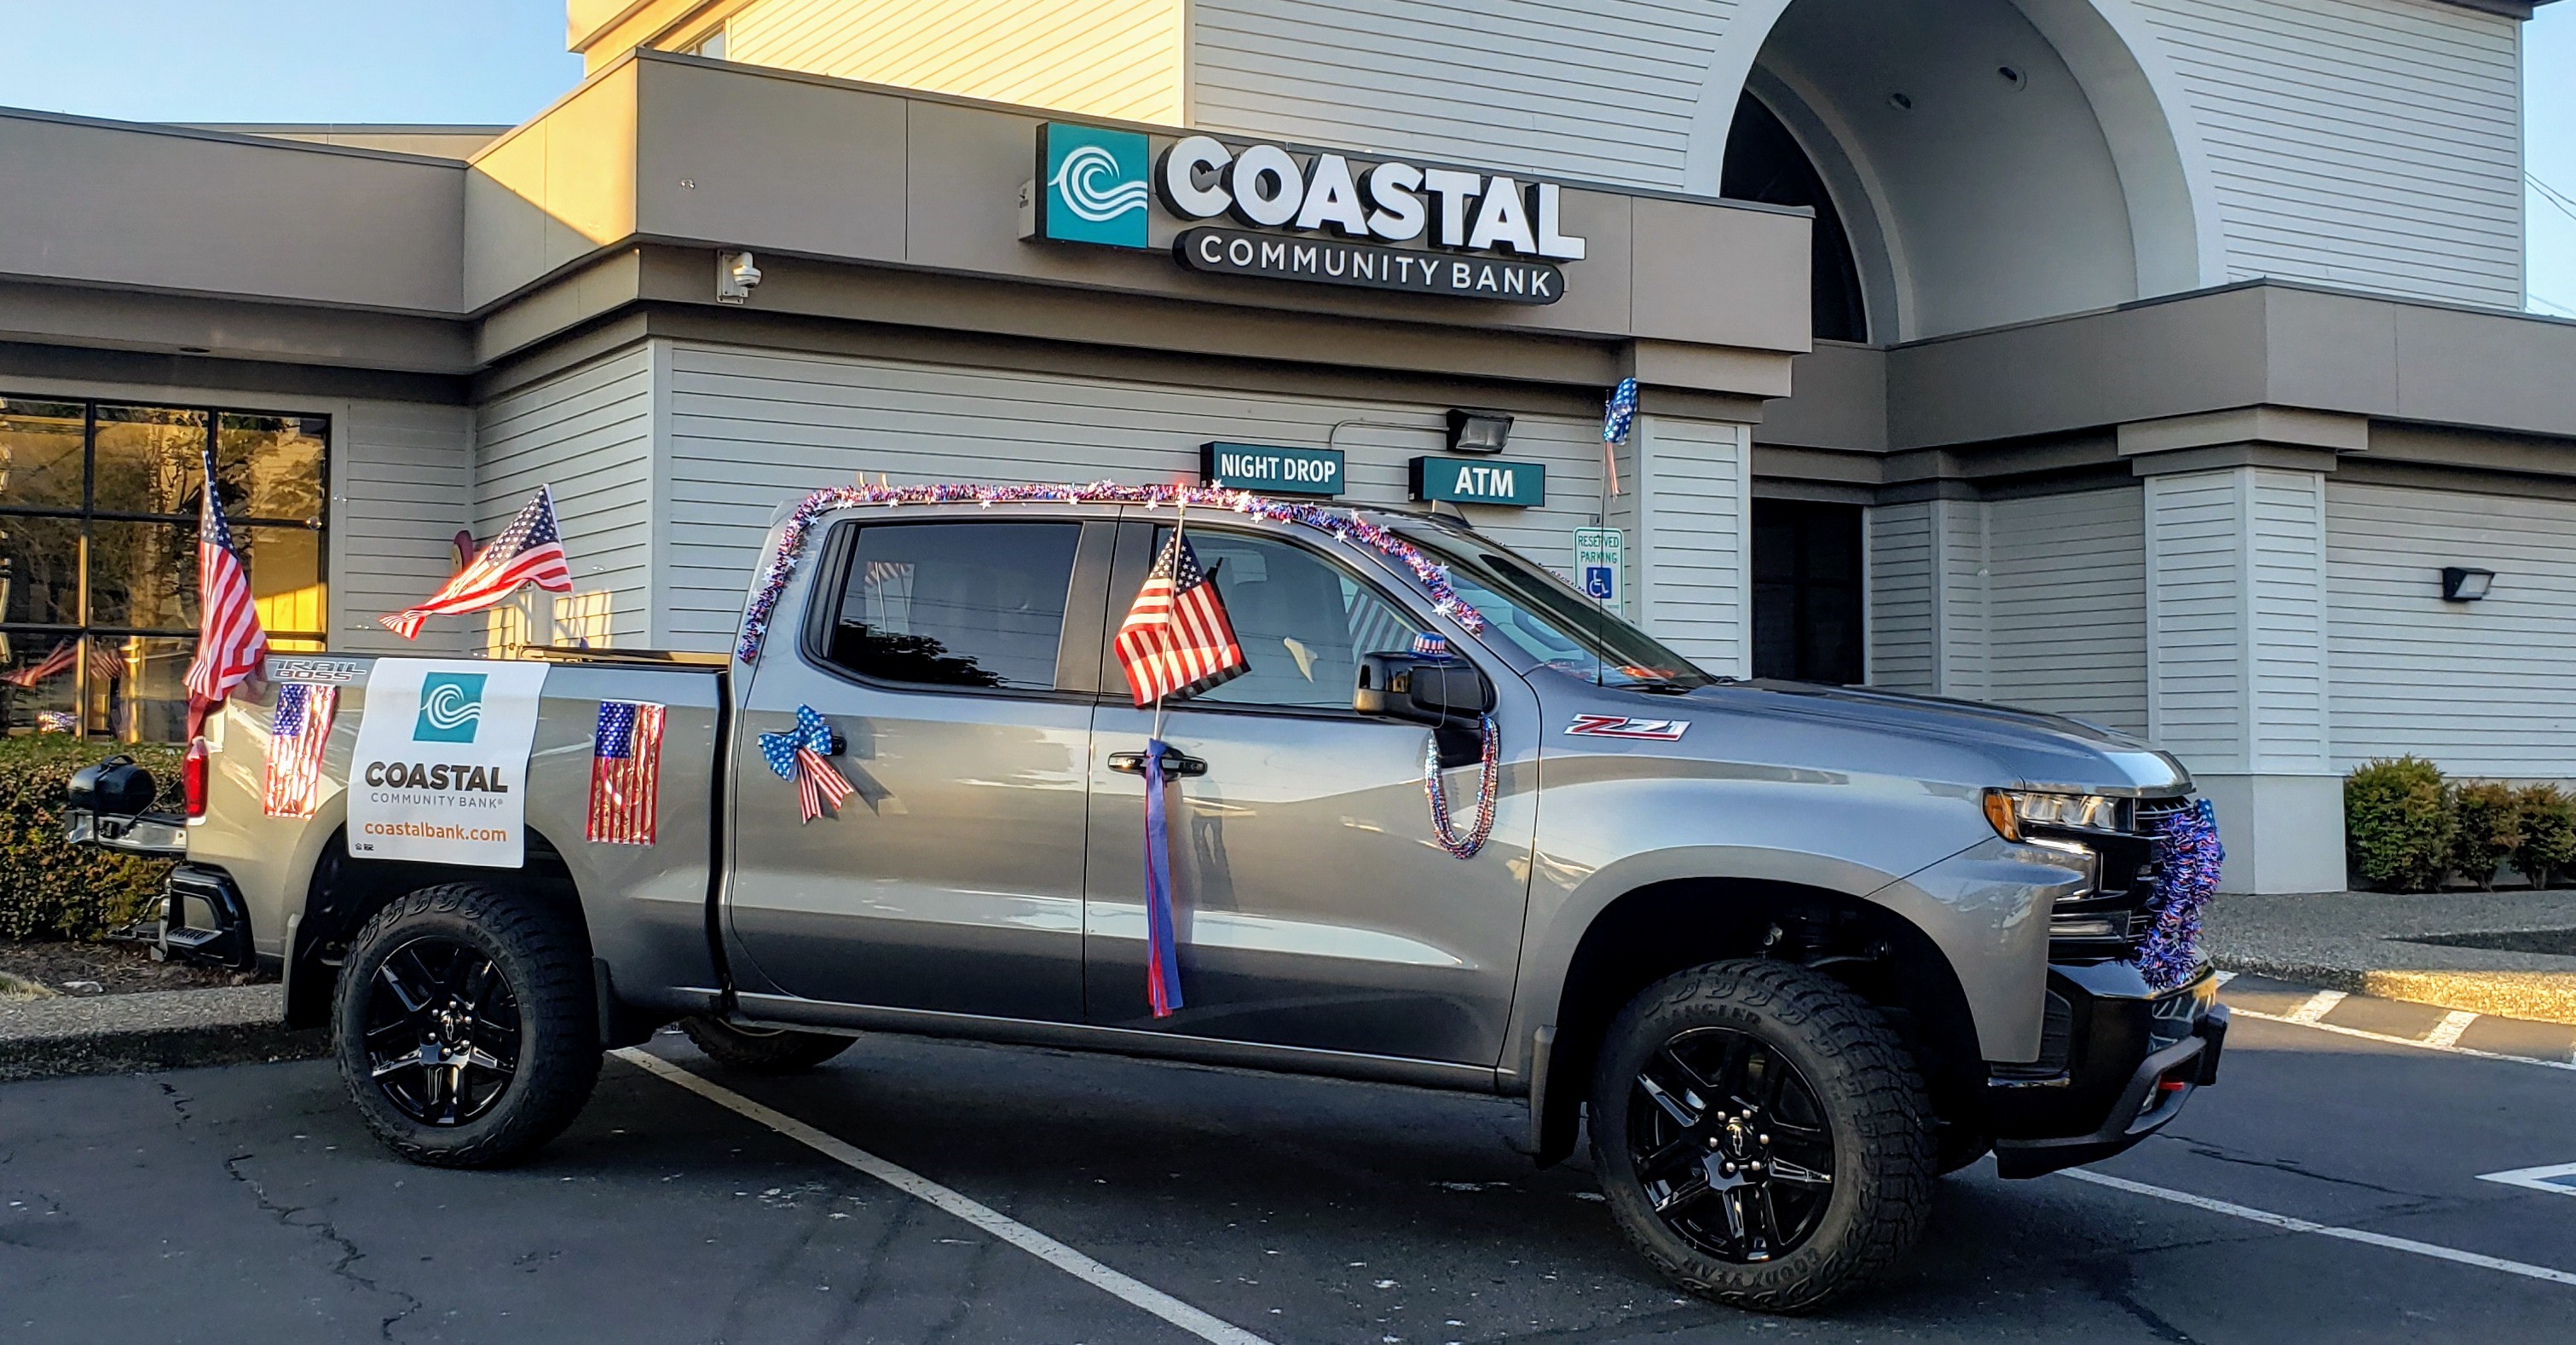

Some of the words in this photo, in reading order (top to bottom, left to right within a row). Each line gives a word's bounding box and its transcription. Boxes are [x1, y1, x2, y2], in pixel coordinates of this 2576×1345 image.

[1159, 135, 1586, 260] COASTAL
[1199, 234, 1438, 286] COMMUNITY
[1452, 263, 1551, 297] BANK
[1220, 453, 1280, 481] NIGHT
[1283, 457, 1337, 484] DROP
[1454, 466, 1515, 498] ATM
[1580, 551, 1618, 564] PARKNG
[267, 659, 367, 674] TRAIL
[274, 669, 352, 681] BOSS
[1563, 713, 1692, 742] Z71
[365, 761, 509, 794] COASTAL
[371, 792, 455, 807] COMMUNITY
[364, 821, 507, 842] coastalbank.com
